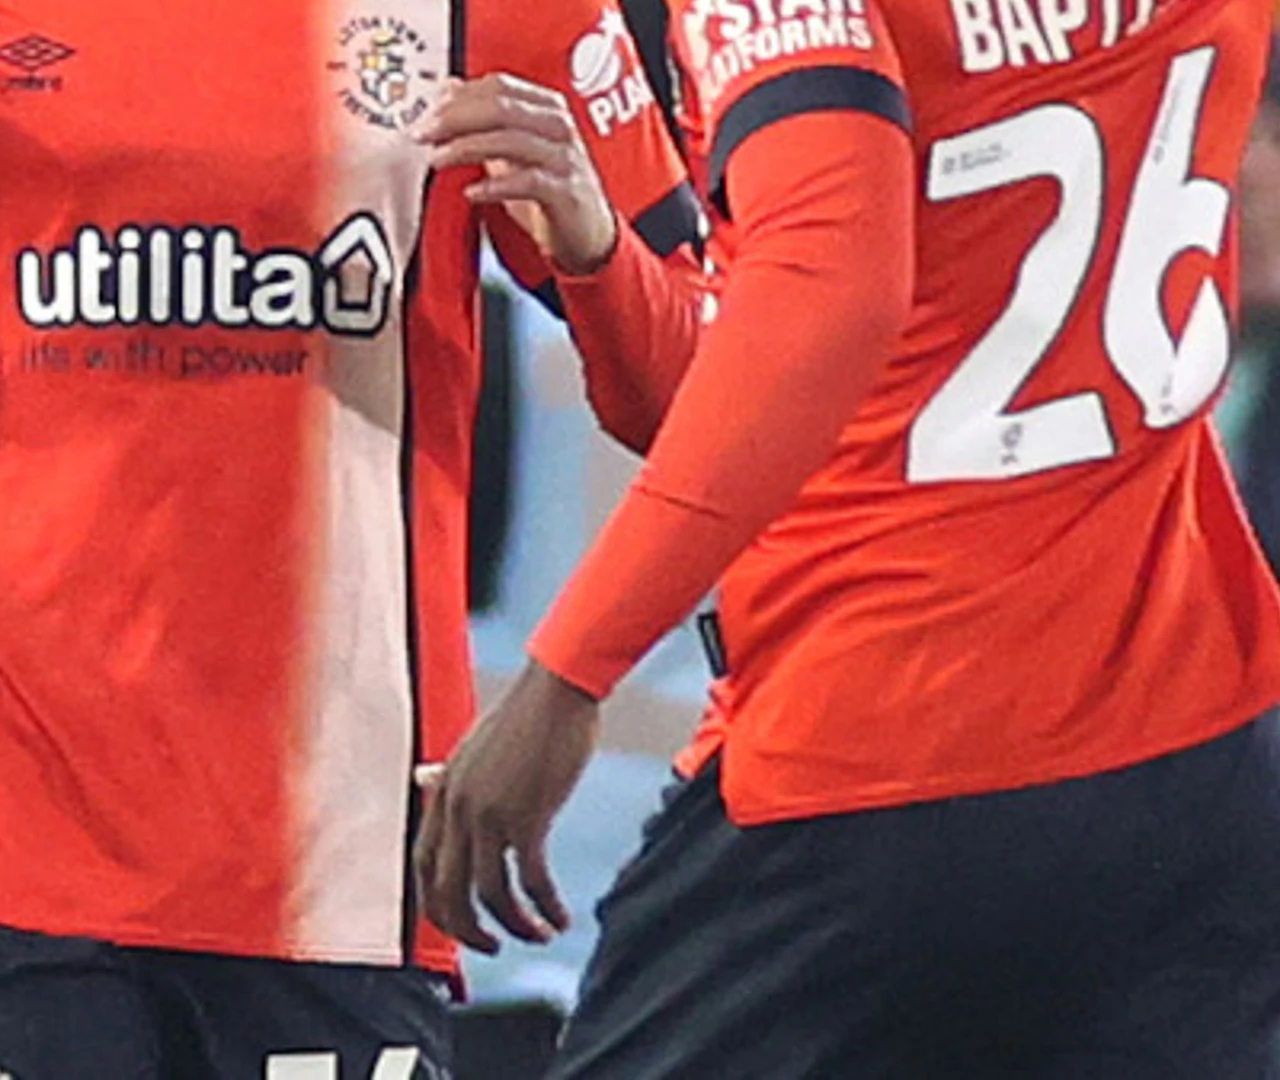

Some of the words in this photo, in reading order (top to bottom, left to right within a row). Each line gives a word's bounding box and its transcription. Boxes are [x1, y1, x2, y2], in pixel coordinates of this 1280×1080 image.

[18, 225, 316, 329] utilita
[906, 44, 1232, 484] 26
[181, 346, 309, 379] power
